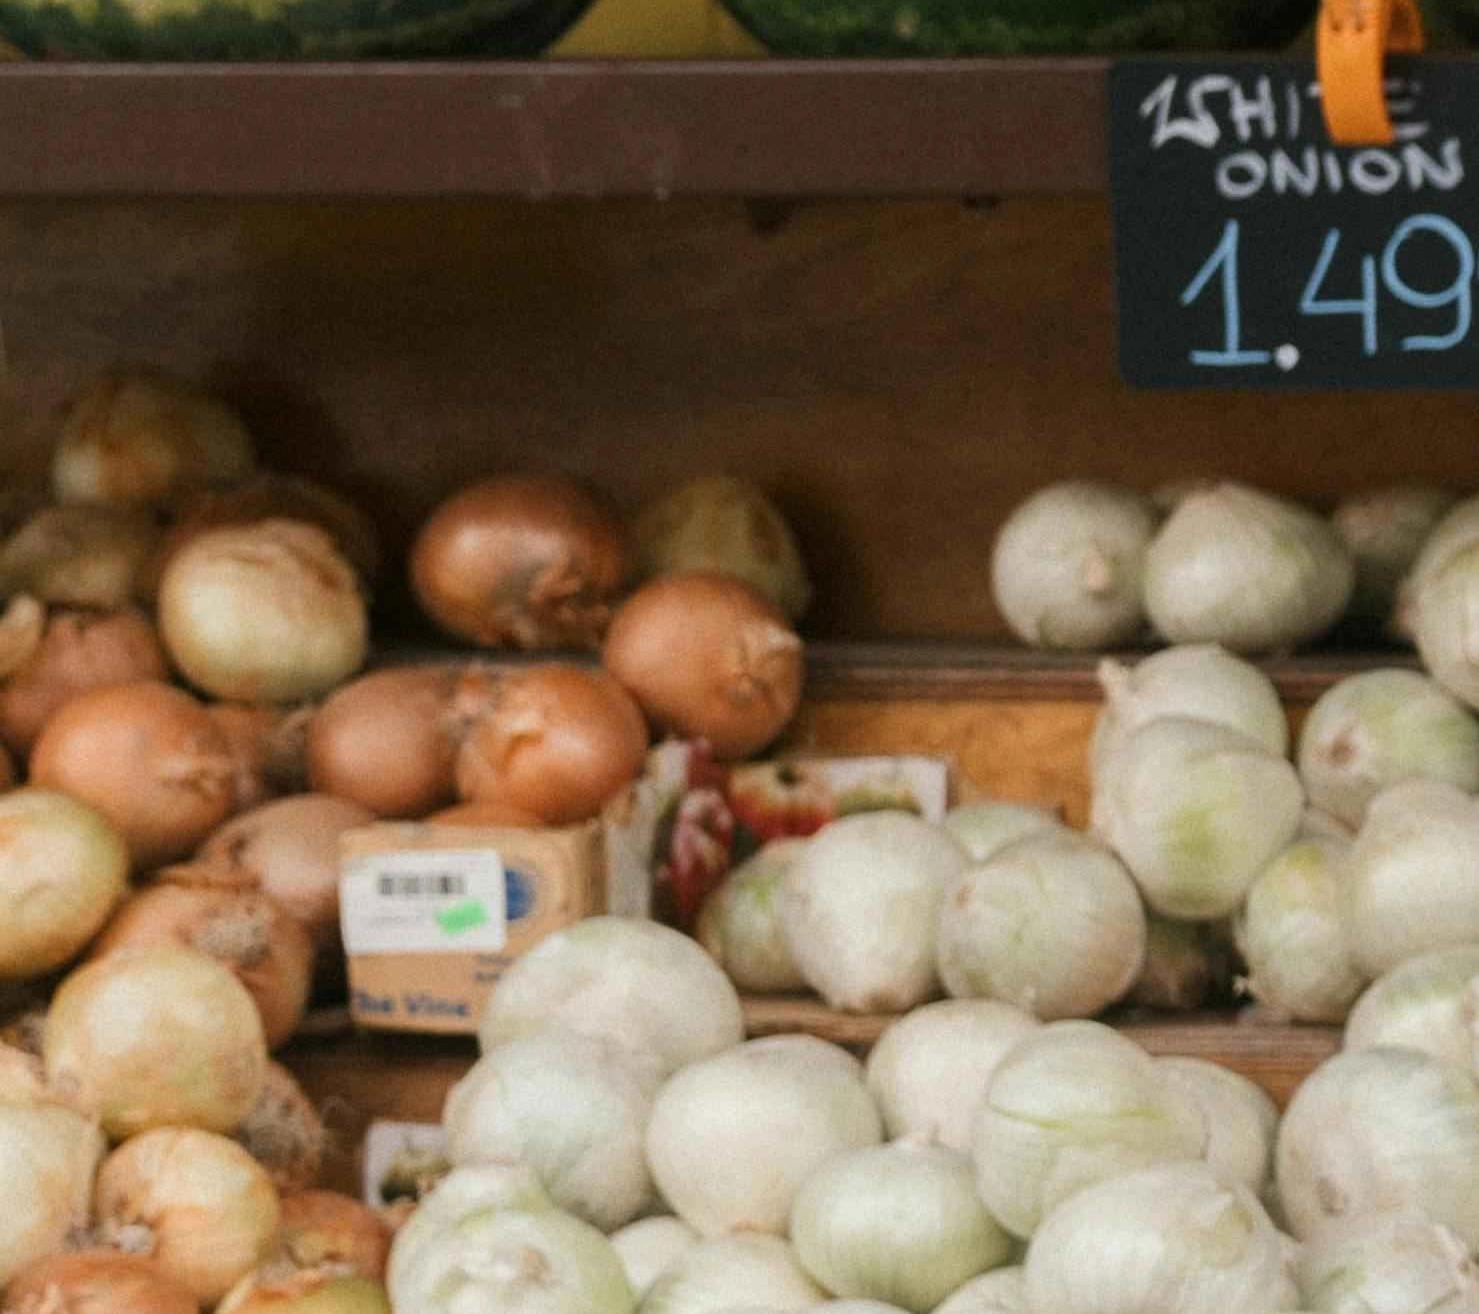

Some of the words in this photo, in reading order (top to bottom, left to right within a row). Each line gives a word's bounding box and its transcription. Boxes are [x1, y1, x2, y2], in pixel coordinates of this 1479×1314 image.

[1139, 74, 1431, 148] WHIE
[1214, 136, 1465, 200] ONION
[1180, 213, 1475, 372] 1.49
